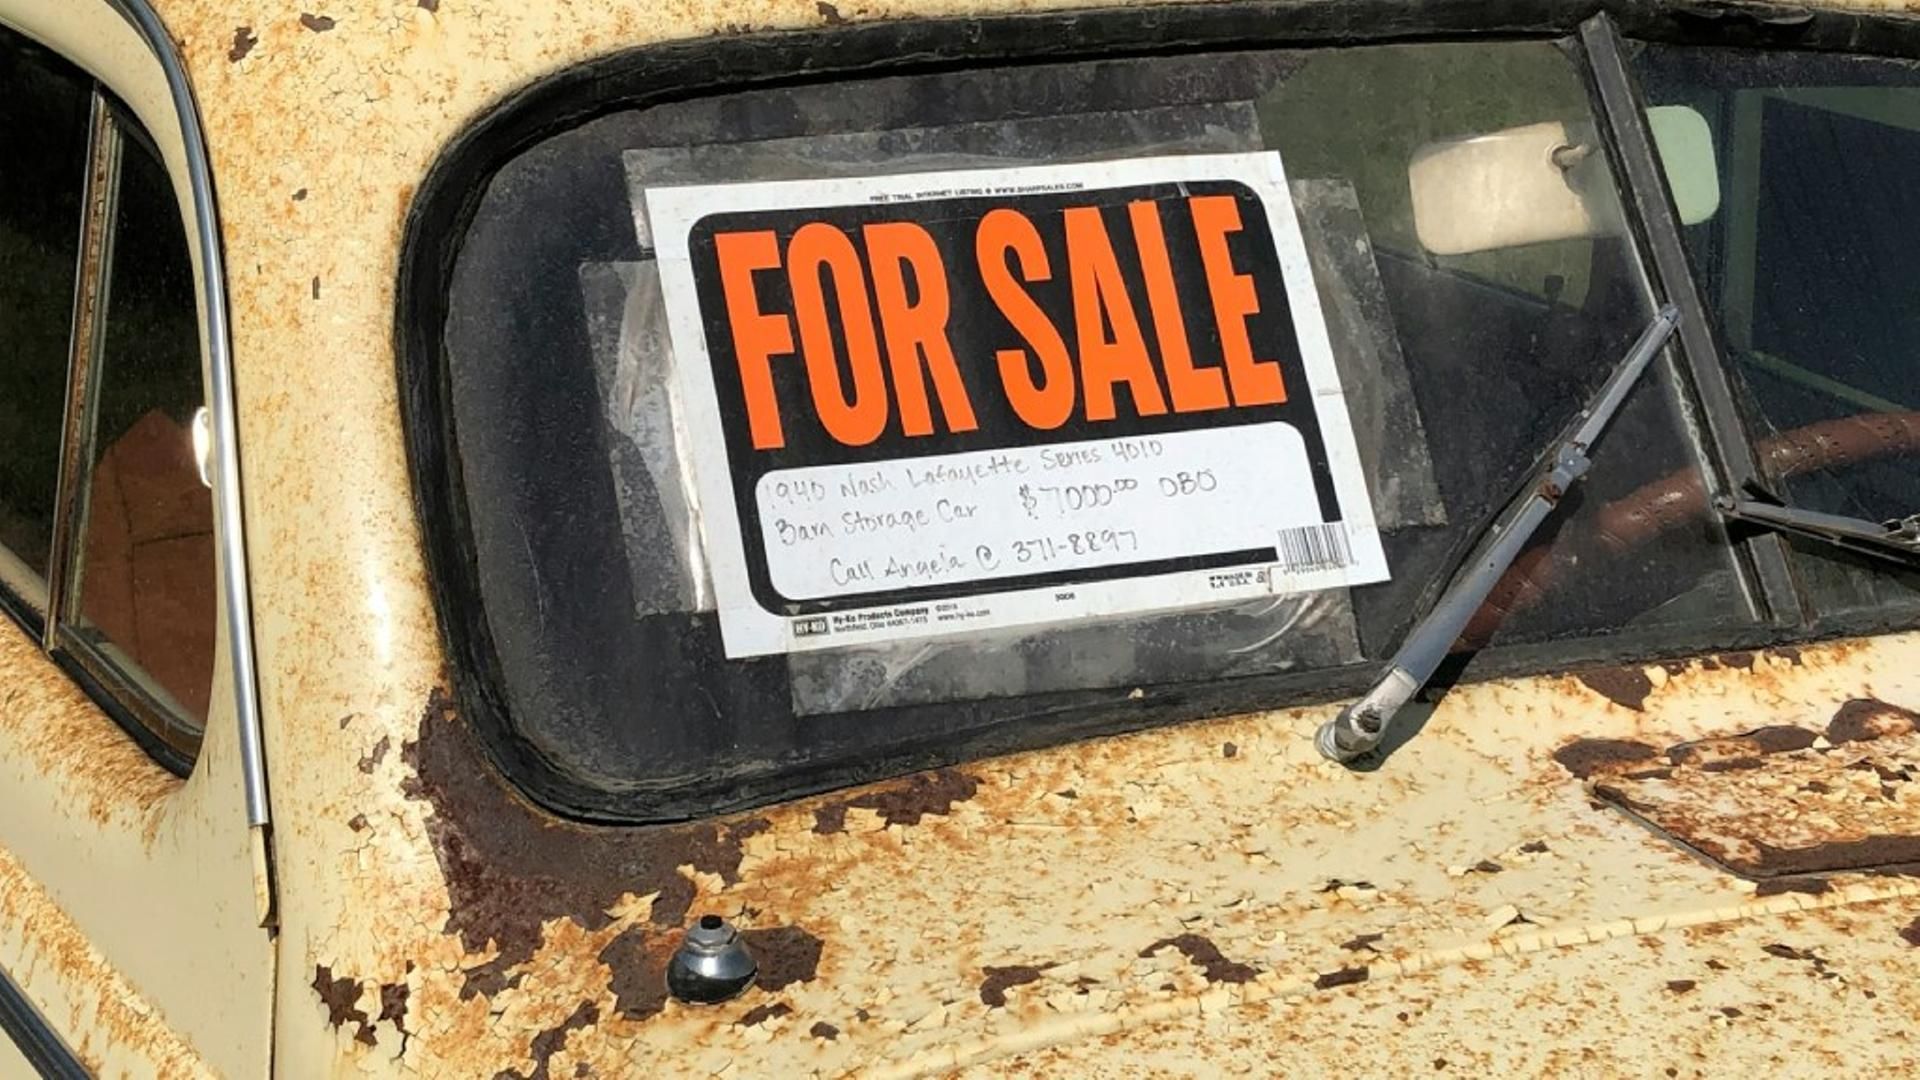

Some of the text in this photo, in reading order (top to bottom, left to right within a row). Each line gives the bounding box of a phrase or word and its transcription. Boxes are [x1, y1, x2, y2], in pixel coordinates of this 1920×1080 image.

[892, 192, 914, 201] TRIAL
[715, 194, 1288, 450] FOR SALE
[765, 479, 826, 510] 1940
[840, 471, 896, 499] Nash
[1111, 439, 1164, 462] 4010
[775, 517, 835, 546] Barn
[841, 508, 931, 536] Storage
[936, 498, 979, 523] Car
[1158, 468, 1218, 498] OBO
[829, 557, 876, 587] Call
[1011, 529, 1139, 563] 371-8897
[858, 611, 893, 622] Products
[894, 607, 929, 618] Company
